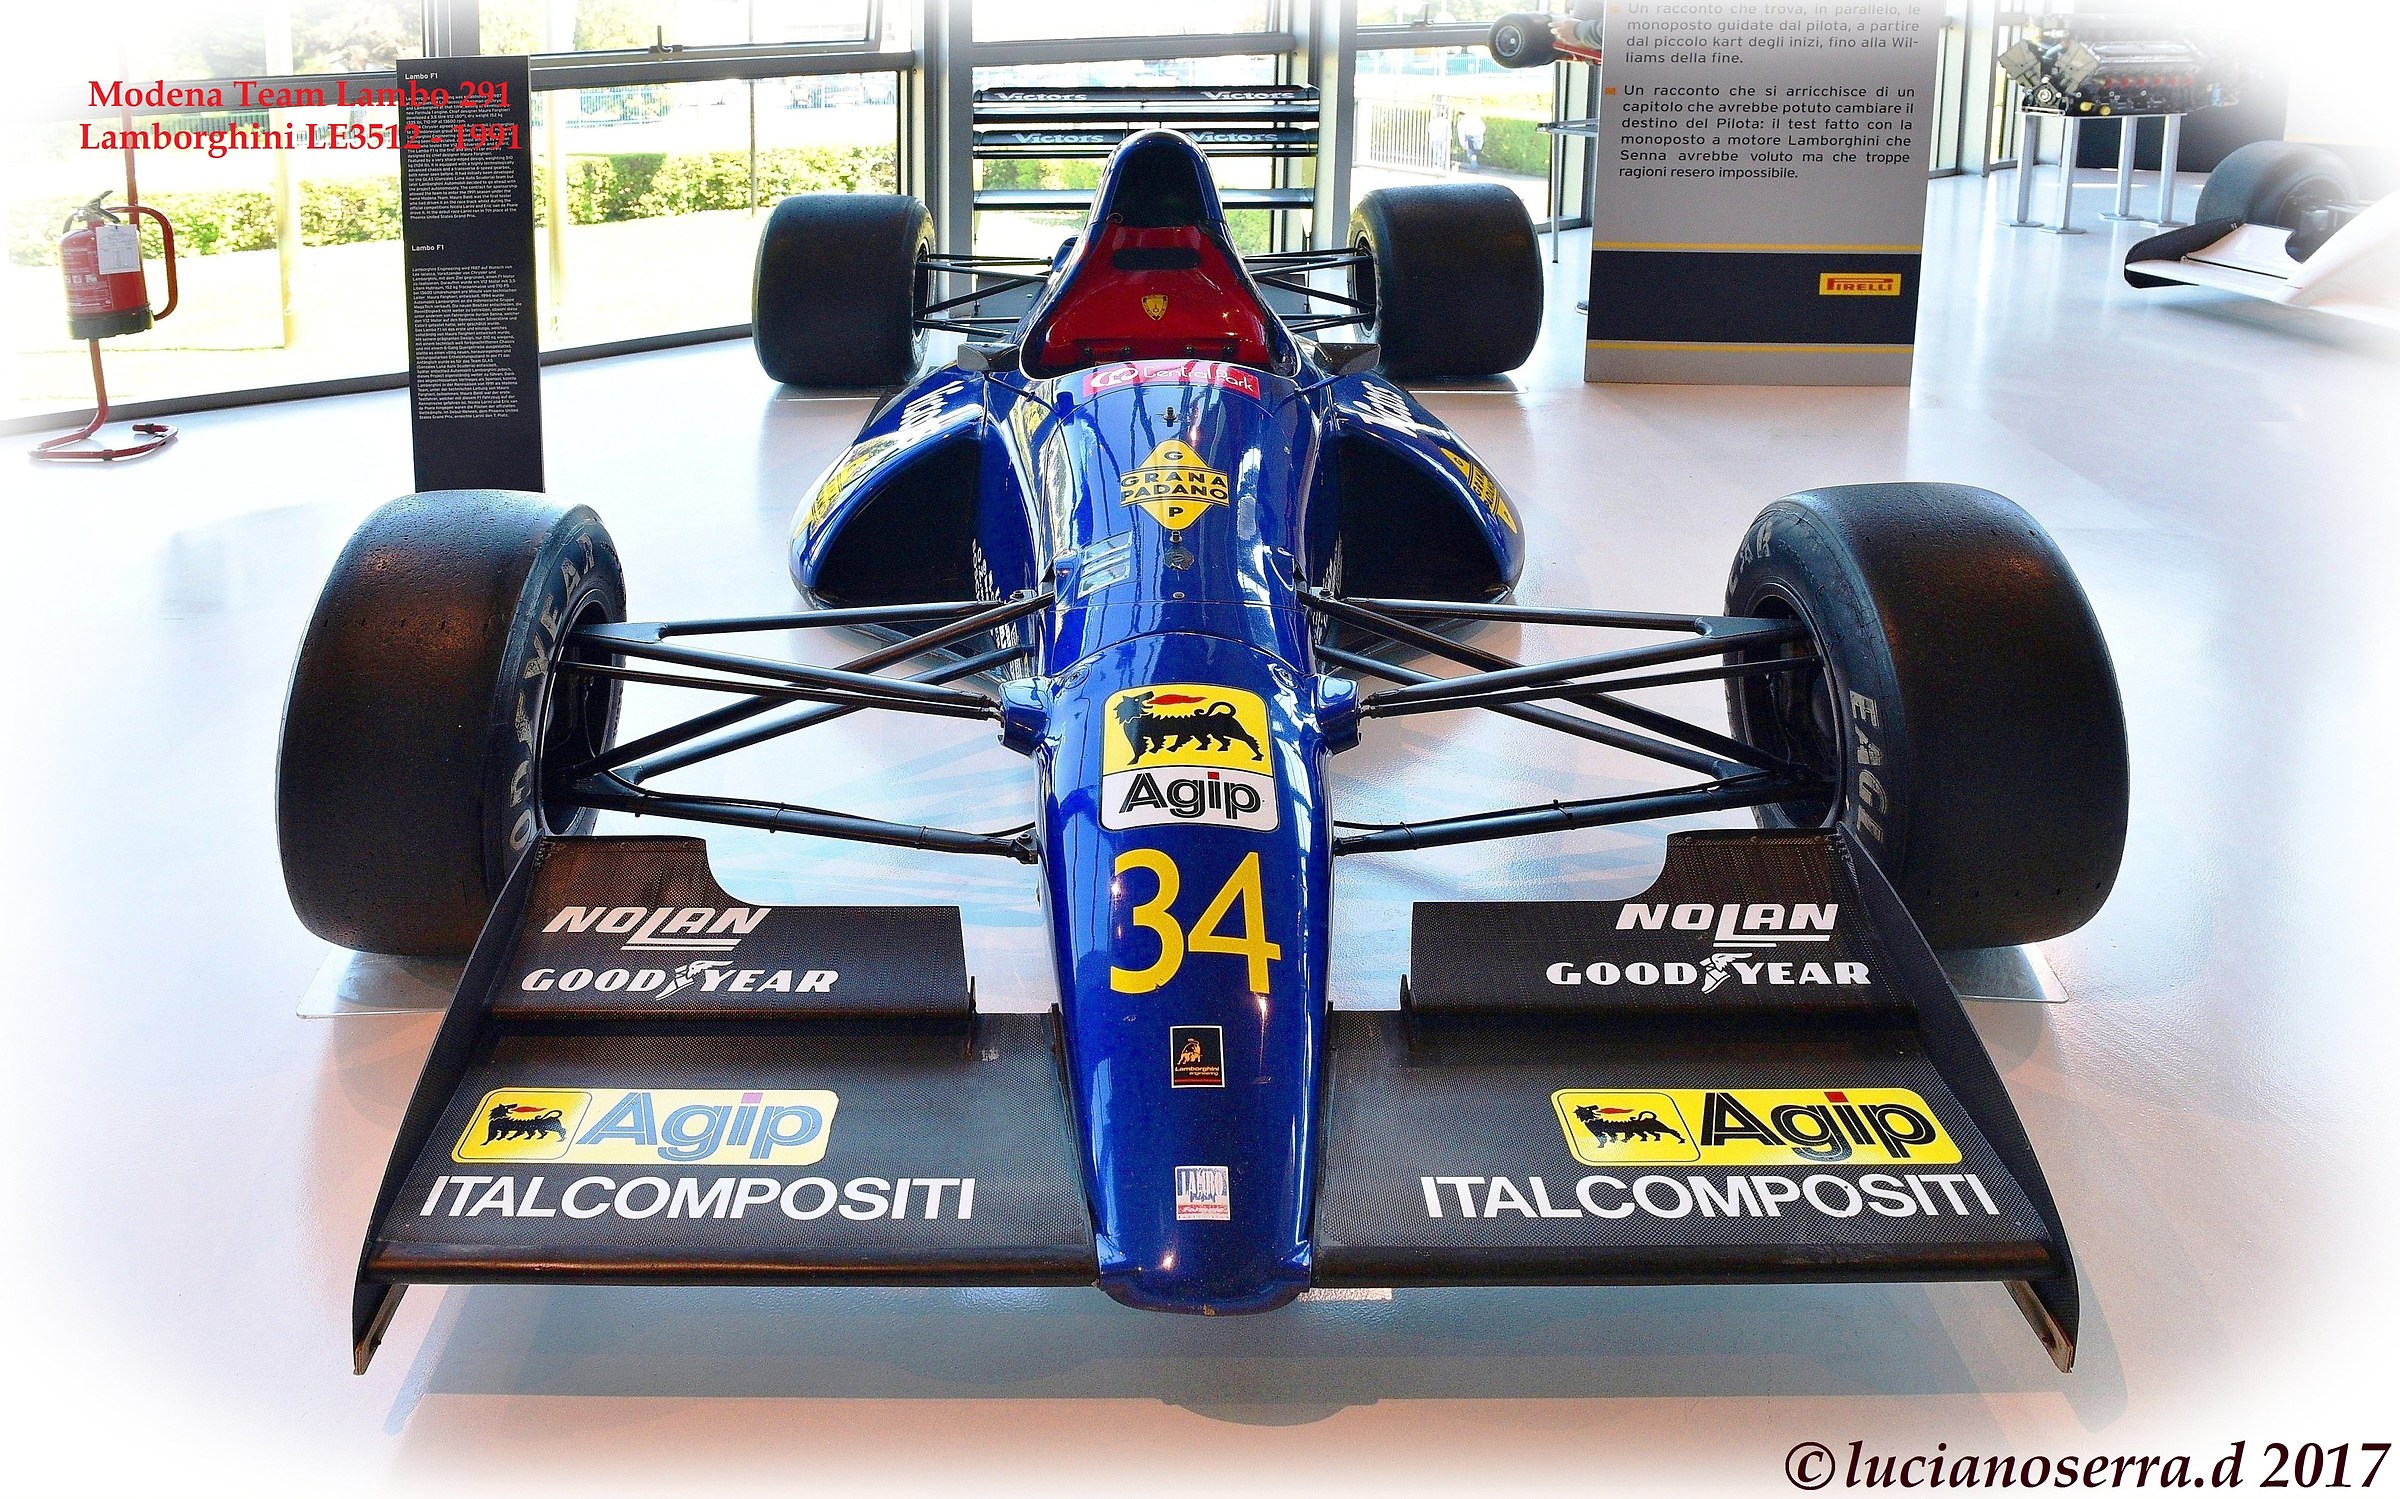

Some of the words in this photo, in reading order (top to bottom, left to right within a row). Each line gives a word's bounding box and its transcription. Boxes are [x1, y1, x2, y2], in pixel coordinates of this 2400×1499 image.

[1628, 2, 1649, 14] Un
[1656, 2, 1723, 15] racconto
[1730, 3, 1757, 15] che
[1764, 3, 1807, 16] trova,
[1814, 2, 1828, 15] in
[1834, 3, 1901, 17] parallelo,
[1908, 3, 1921, 16] le
[1627, 19, 1713, 33] monoposto
[1717, 19, 1774, 34] guidate
[1778, 19, 1801, 31] dal
[1806, 20, 1851, 33] pilota,
[1856, 22, 1865, 32] a
[1870, 20, 1920, 34] partire
[1626, 35, 1649, 47] dal
[1654, 35, 1708, 49] piccolo
[1712, 35, 1743, 48] kart
[1748, 36, 1784, 50] degli
[1789, 36, 1823, 49] inizi,
[1828, 36, 1857, 48] fino
[1860, 36, 1887, 48] alla
[1891, 36, 1919, 48] Wil-
[1625, 51, 1666, 64] liams
[1670, 52, 1707, 64] della
[1711, 51, 1743, 64] fine.
[995, 92, 1087, 101] Victors
[1200, 91, 1295, 100] Victors
[1624, 84, 1644, 96] Un
[1653, 85, 1720, 97] racconto
[1729, 85, 1756, 97] che
[1765, 84, 1777, 97] si
[1785, 85, 1867, 98] arricchisce
[1875, 86, 1889, 98] di
[1897, 88, 1915, 98] un
[1622, 100, 1684, 115] capitolo
[1687, 101, 1714, 113] che
[1717, 101, 1779, 113] avrebbe
[1782, 102, 1832, 115] potuto
[1835, 102, 1902, 114] cambiare
[1906, 102, 1914, 114] il
[1621, 117, 1678, 129] destino
[1685, 117, 1708, 129] del
[1716, 117, 1764, 129] Pilota:
[1772, 118, 1780, 129] il
[1788, 118, 1817, 130] test
[1824, 118, 1860, 130] fatto
[1866, 121, 1893, 130] con
[1900, 119, 1913, 131] la
[1012, 133, 1104, 144] Victors
[1187, 131, 1278, 143] Victors
[1620, 134, 1706, 147] monoposto
[1711, 136, 1721, 145] a
[1727, 134, 1782, 146] motore
[1788, 134, 1880, 149] Lamborghini
[1885, 135, 1912, 147] che
[1620, 149, 1667, 161] Senna
[1678, 150, 1739, 162] avrebbe
[1750, 150, 1794, 162] voluto
[1802, 153, 1824, 163] ma
[1832, 151, 1857, 163] che
[1866, 151, 1911, 165] troppe
[1619, 167, 1667, 180] ragioni
[1670, 168, 1715, 178] resero
[1718, 166, 1798, 180] impossibile.
[1826, 278, 1894, 291] PIRELLI
[1143, 366, 1211, 380] Central
[1215, 367, 1255, 393] Park
[1164, 451, 1184, 461] G
[1121, 471, 1228, 488] GRANA
[1122, 485, 1229, 501] PADANO
[1168, 506, 1185, 517] P
[1119, 771, 1261, 820] Agip
[542, 906, 772, 948] NOLAN
[1110, 848, 1282, 994] 34
[1615, 903, 1839, 946] NOLAN
[577, 1091, 823, 1162] Agip
[1699, 1091, 1936, 1162] Agip
[420, 1175, 977, 1221] ITALCOMPOSITI
[1420, 1174, 2002, 1219] ITALCOMPOSITI
